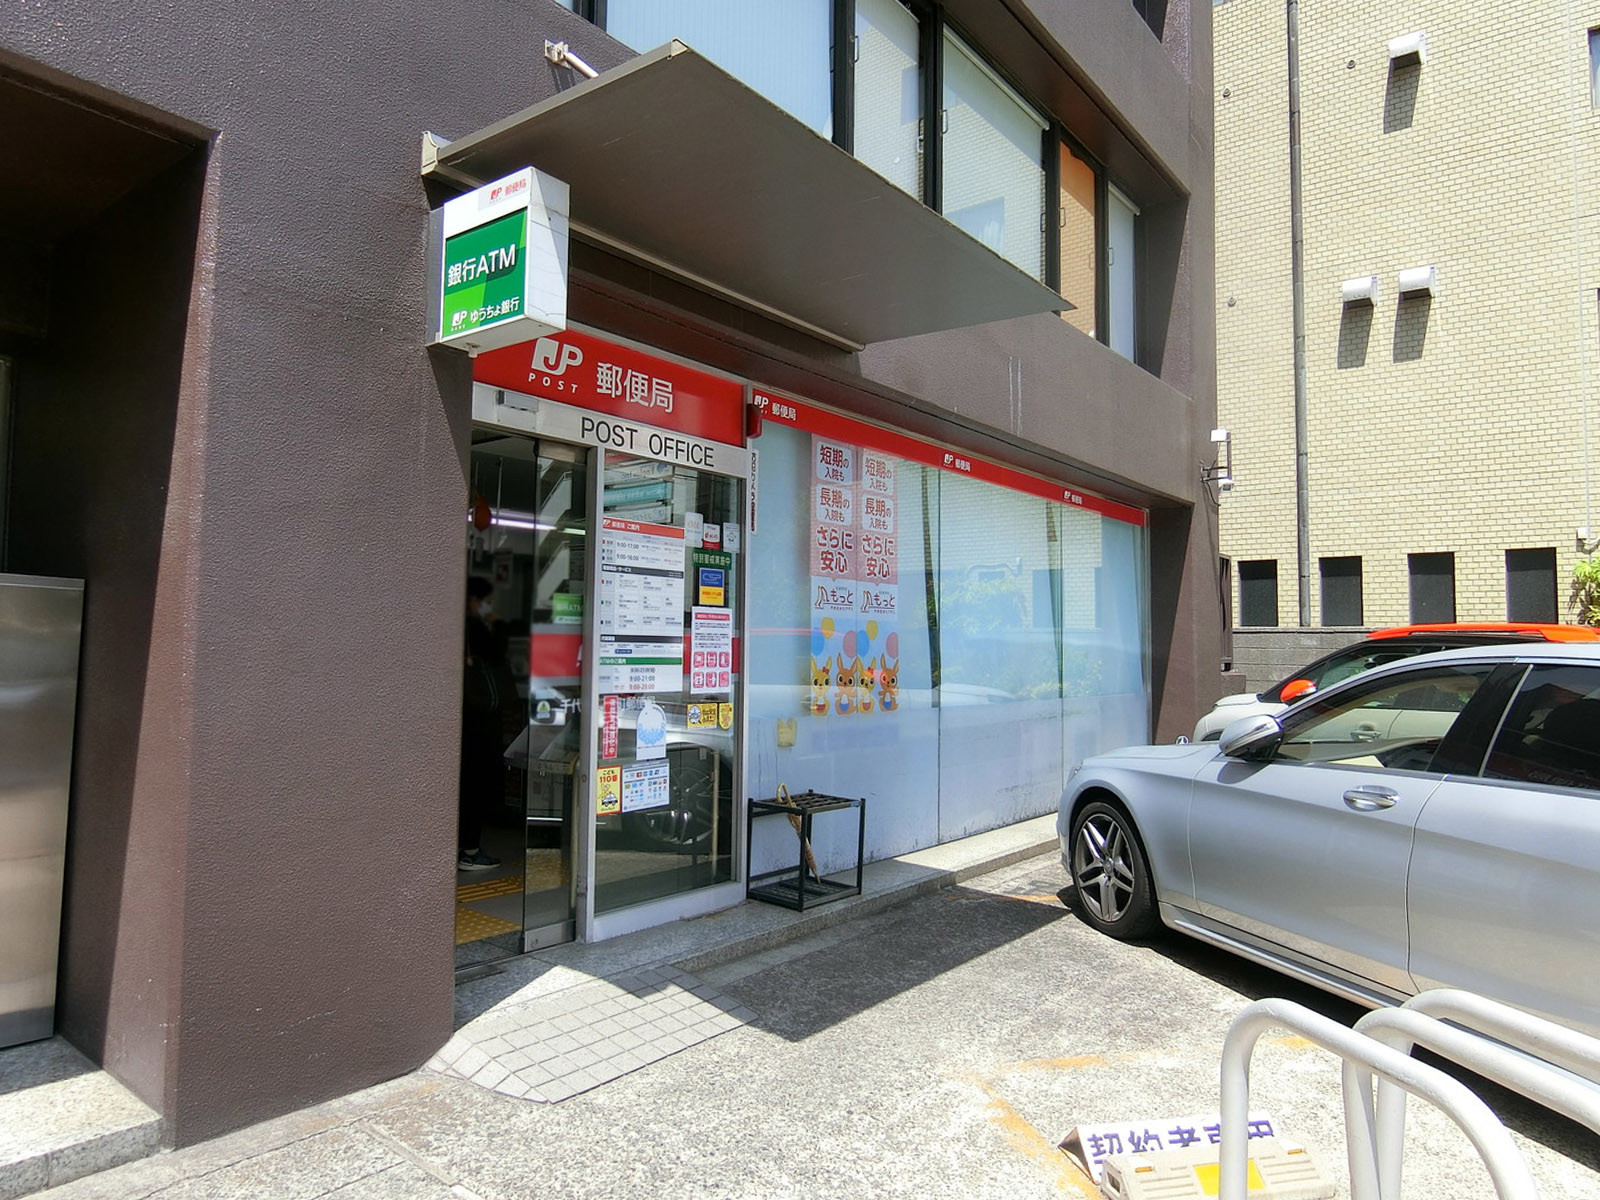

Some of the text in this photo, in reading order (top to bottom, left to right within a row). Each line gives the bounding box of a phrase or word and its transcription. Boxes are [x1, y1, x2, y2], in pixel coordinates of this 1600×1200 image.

[447, 243, 516, 288] 銀行ATM
[470, 296, 520, 324] ゆうちょ銀行
[528, 372, 579, 394] POST
[596, 361, 674, 413] 郵便局
[771, 402, 797, 421] 郵便局
[581, 416, 715, 468] POST OFFICE
[820, 444, 850, 469] 短期の
[824, 466, 845, 482] 入院も
[865, 456, 893, 480] 短期の
[869, 477, 888, 492] 入院も
[820, 487, 850, 509] 長期の
[865, 497, 892, 518] 長期の
[824, 508, 845, 522] 入院も
[869, 517, 889, 530] 入院も
[817, 526, 853, 550] さらに
[862, 534, 895, 556] さらに
[820, 550, 848, 573] 安心
[866, 556, 890, 578] 安心
[830, 588, 854, 604] もっと
[873, 593, 895, 608] もっと
